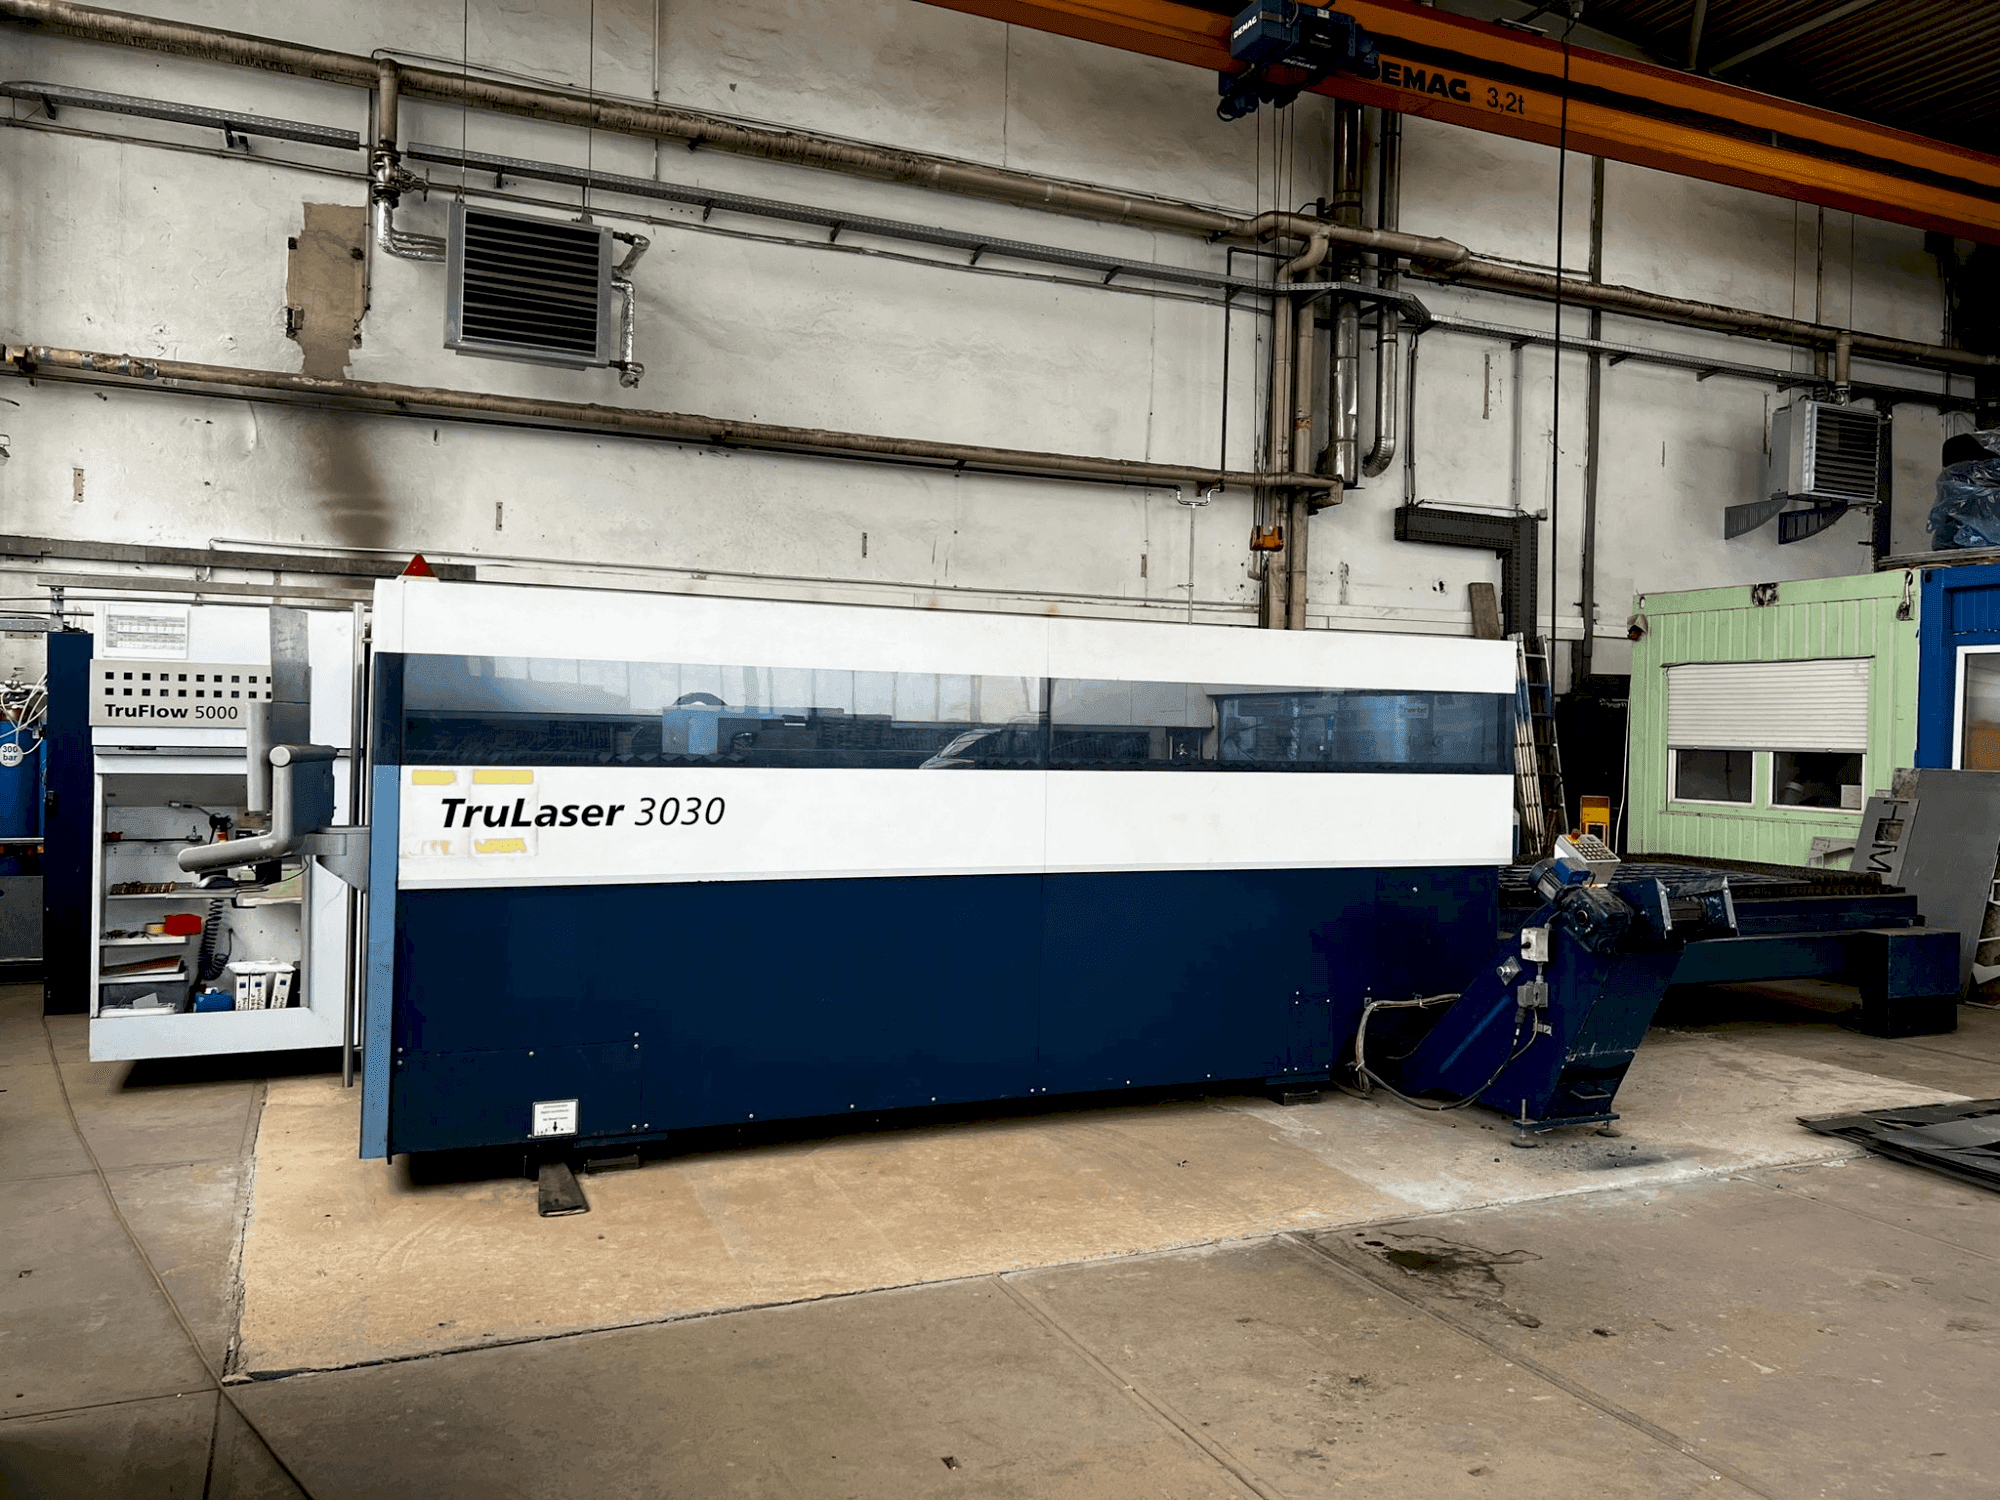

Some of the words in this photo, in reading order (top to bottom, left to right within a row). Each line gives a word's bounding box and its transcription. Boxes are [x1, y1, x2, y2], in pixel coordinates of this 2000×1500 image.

[1233, 15, 1257, 39] DEMAG
[1486, 85, 1525, 115] 3,2t
[104, 703, 189, 719] TruFlow
[195, 705, 238, 719] 5000
[2, 745, 18, 753] 300
[441, 798, 625, 828] TruLaser
[634, 797, 726, 826] 3030
